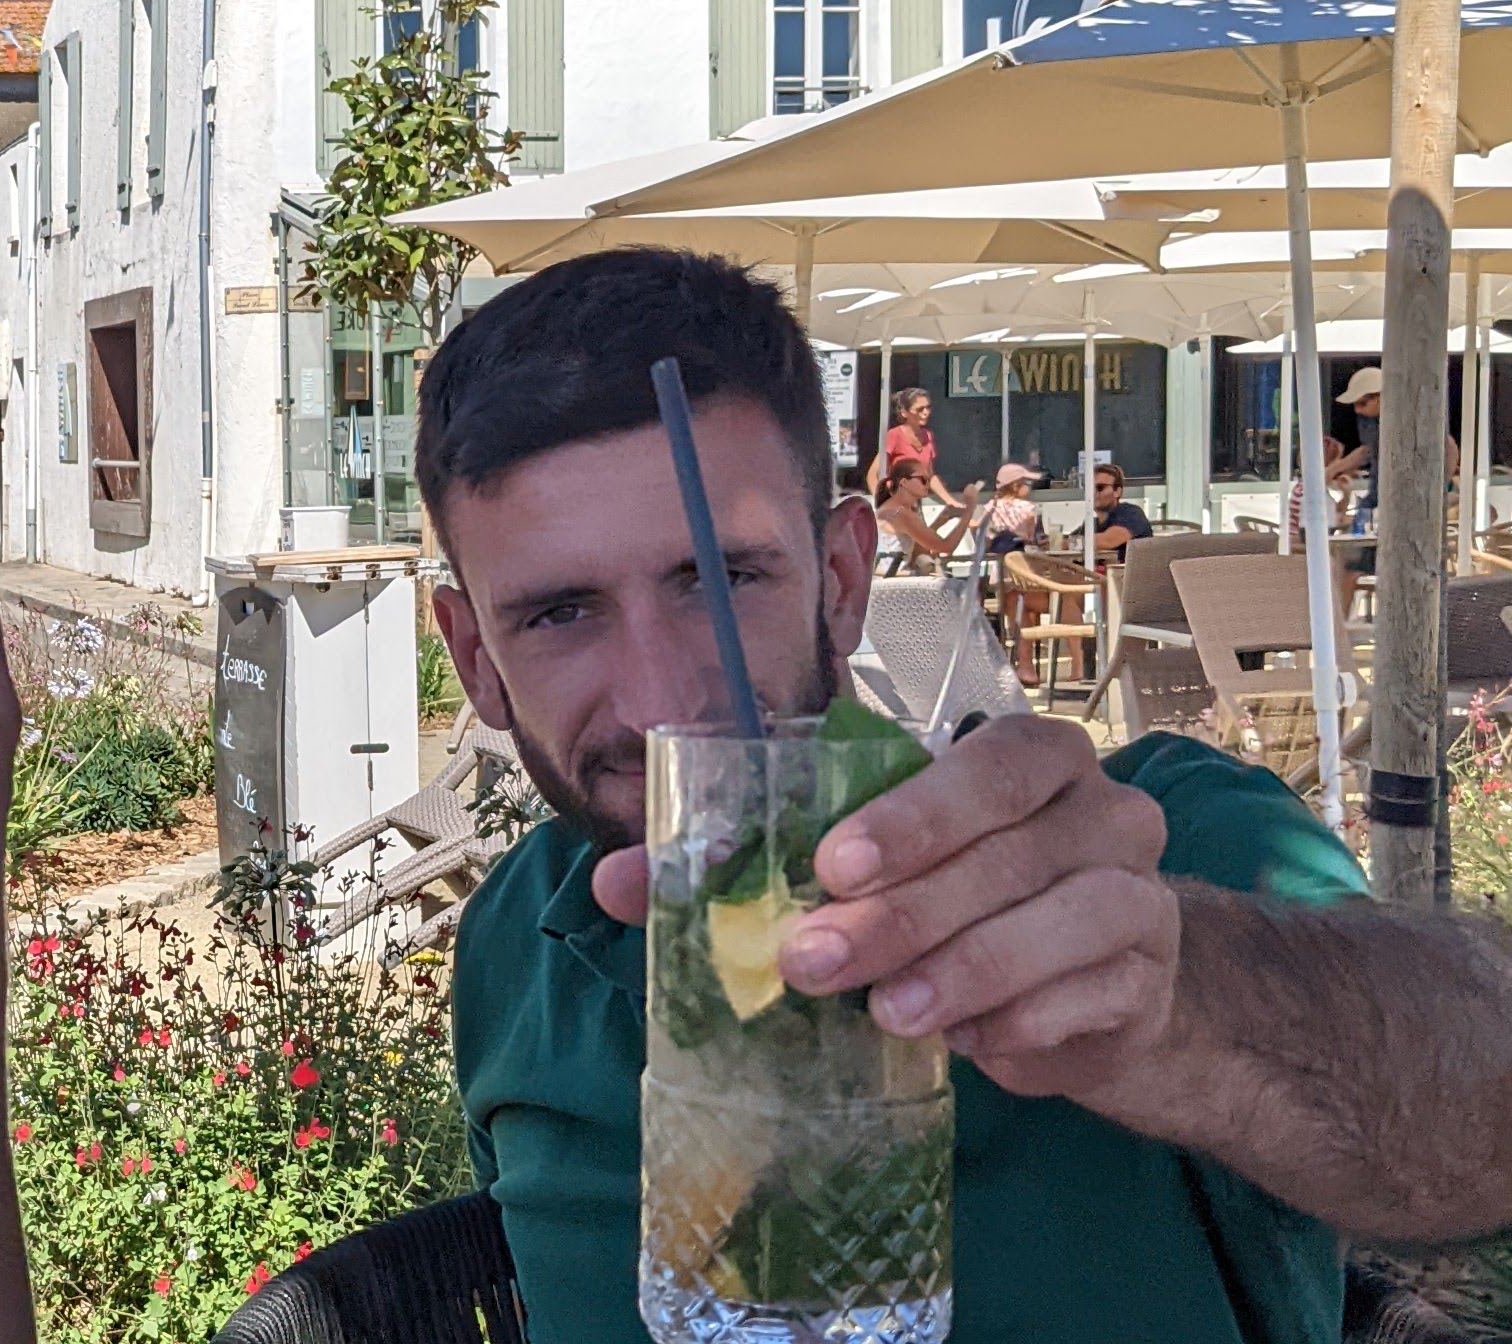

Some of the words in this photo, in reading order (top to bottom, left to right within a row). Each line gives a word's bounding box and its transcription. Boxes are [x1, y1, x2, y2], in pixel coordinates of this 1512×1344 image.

[952, 355, 988, 394] LE
[1019, 353, 1122, 394] WINH
[233, 773, 257, 814] Blé
